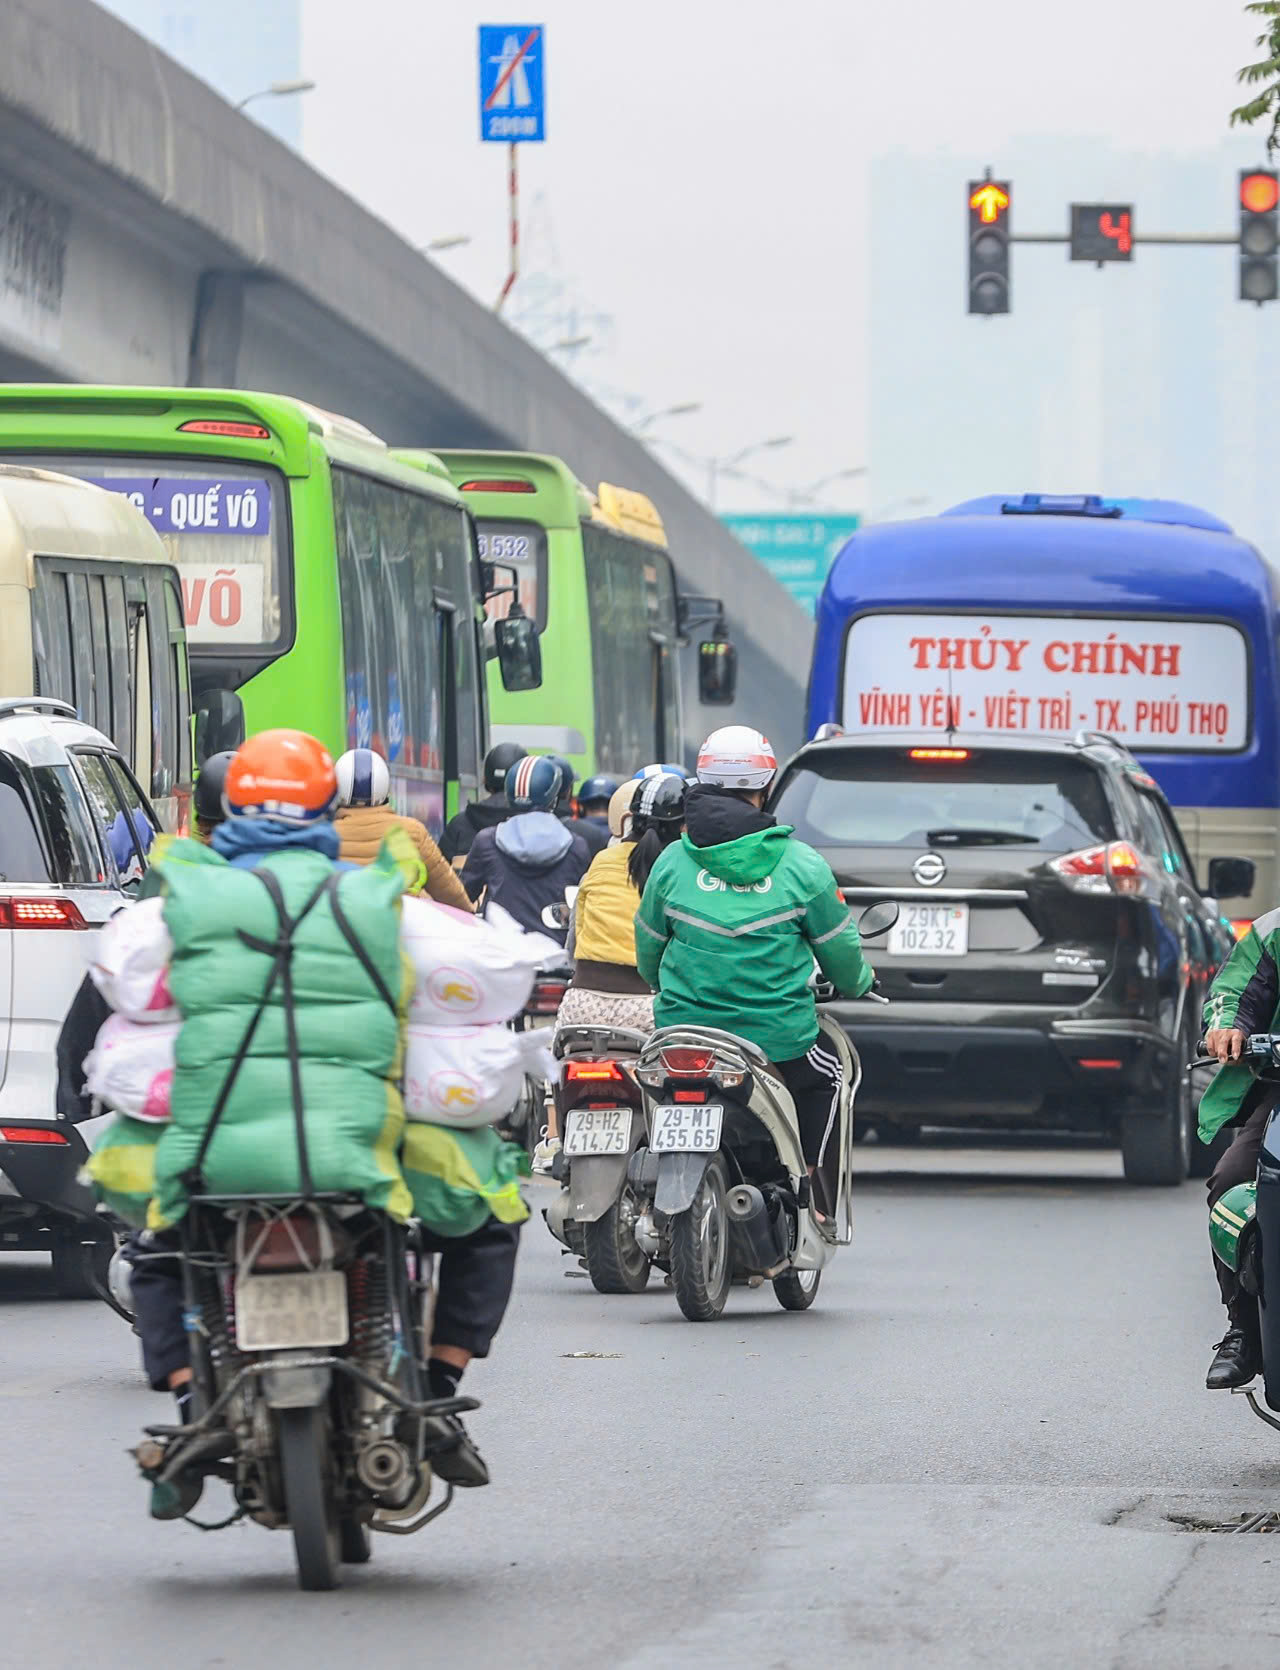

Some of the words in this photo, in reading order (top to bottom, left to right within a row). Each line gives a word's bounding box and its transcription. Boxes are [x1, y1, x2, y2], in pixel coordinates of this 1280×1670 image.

[1100, 212, 1132, 253] 4
[171, 484, 219, 530] QUẾ
[226, 488, 258, 529] VÕ
[491, 535, 529, 560] 532
[182, 569, 241, 627] VÕ
[909, 625, 1029, 672] THỦY
[1043, 632, 1182, 677] CHÍNH
[859, 686, 911, 726] VĨNH
[918, 687, 961, 727] YÊN
[1095, 699, 1127, 732] TX.
[1135, 693, 1179, 734] PHÚ
[1187, 701, 1229, 743] THỌ
[908, 907, 953, 927] 29KT
[900, 929, 955, 950] 102.32
[576, 1112, 621, 1132] 29-H2
[662, 1108, 712, 1128] 29-M1
[569, 1132, 625, 1152] 414.75
[655, 1129, 716, 1149] 455.65
